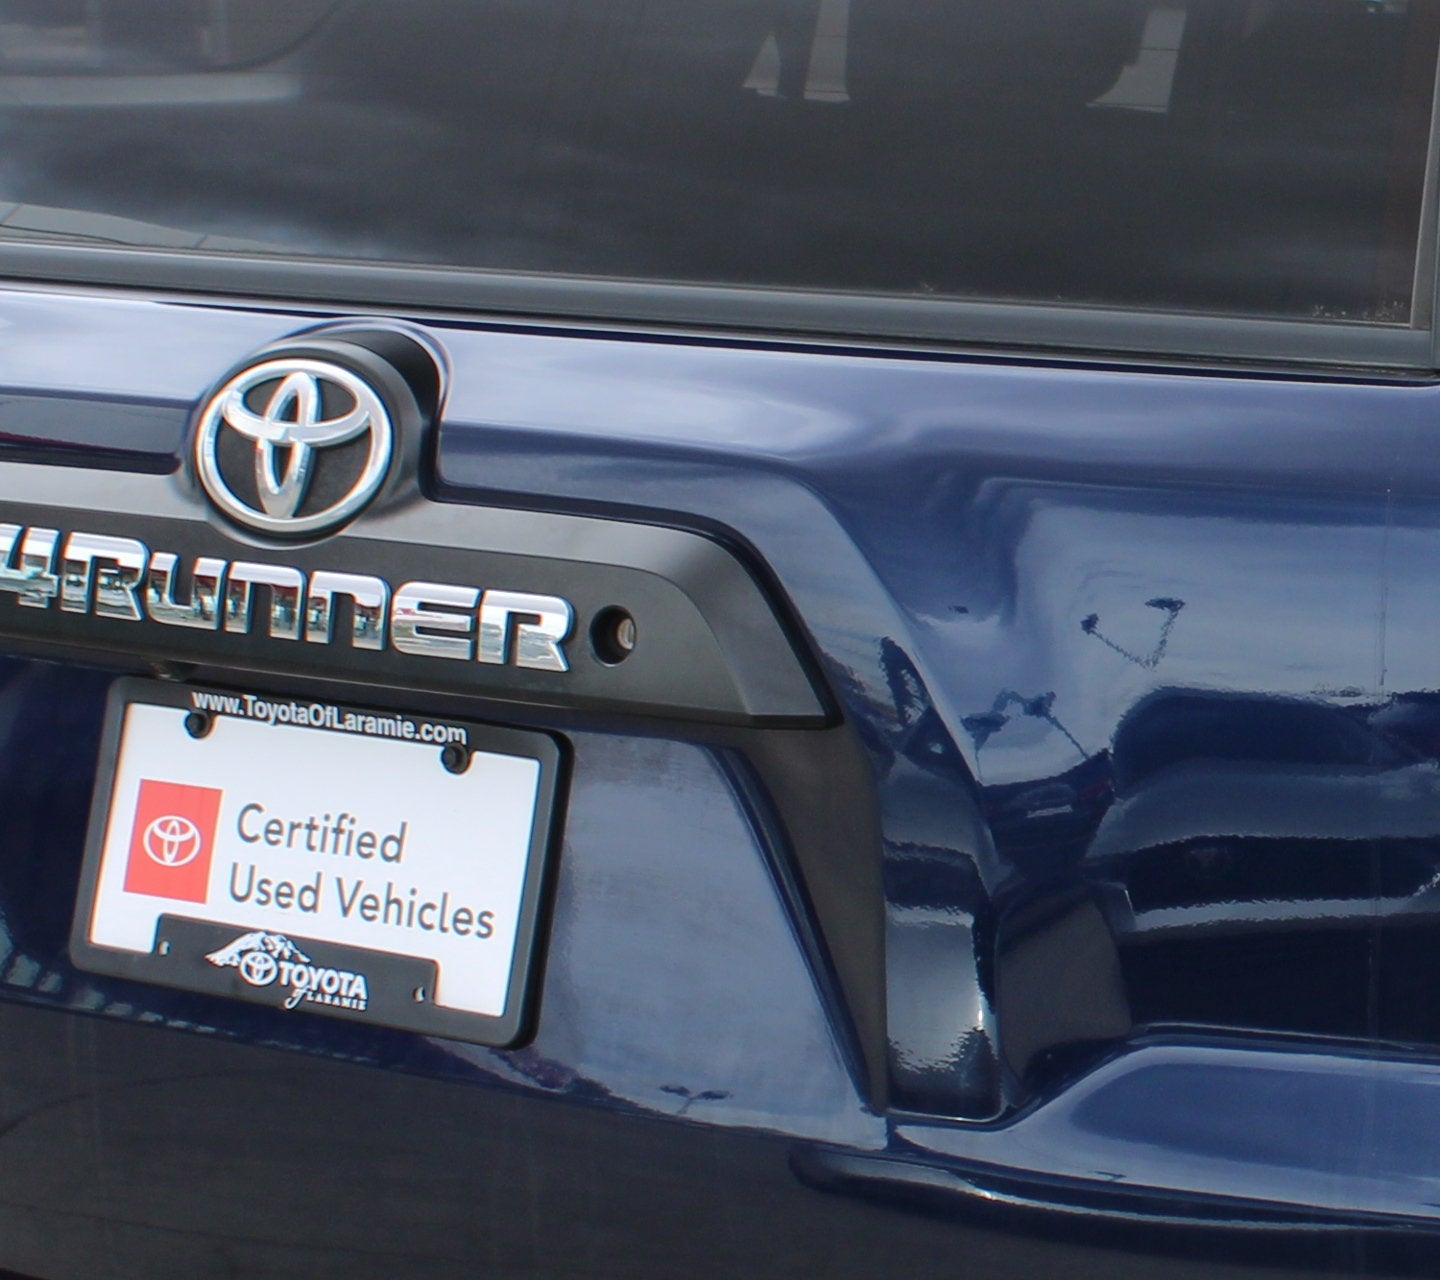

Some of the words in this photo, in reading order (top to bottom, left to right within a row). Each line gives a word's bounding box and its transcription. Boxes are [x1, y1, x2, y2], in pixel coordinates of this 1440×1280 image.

[191, 691, 467, 745] www.ToyotaOfLaramie.com
[237, 802, 408, 863] Certified
[229, 862, 322, 913] Used
[335, 877, 495, 939] Vehicles
[278, 961, 368, 1000] TOYOTA
[307, 991, 367, 1011] LARAMIE
